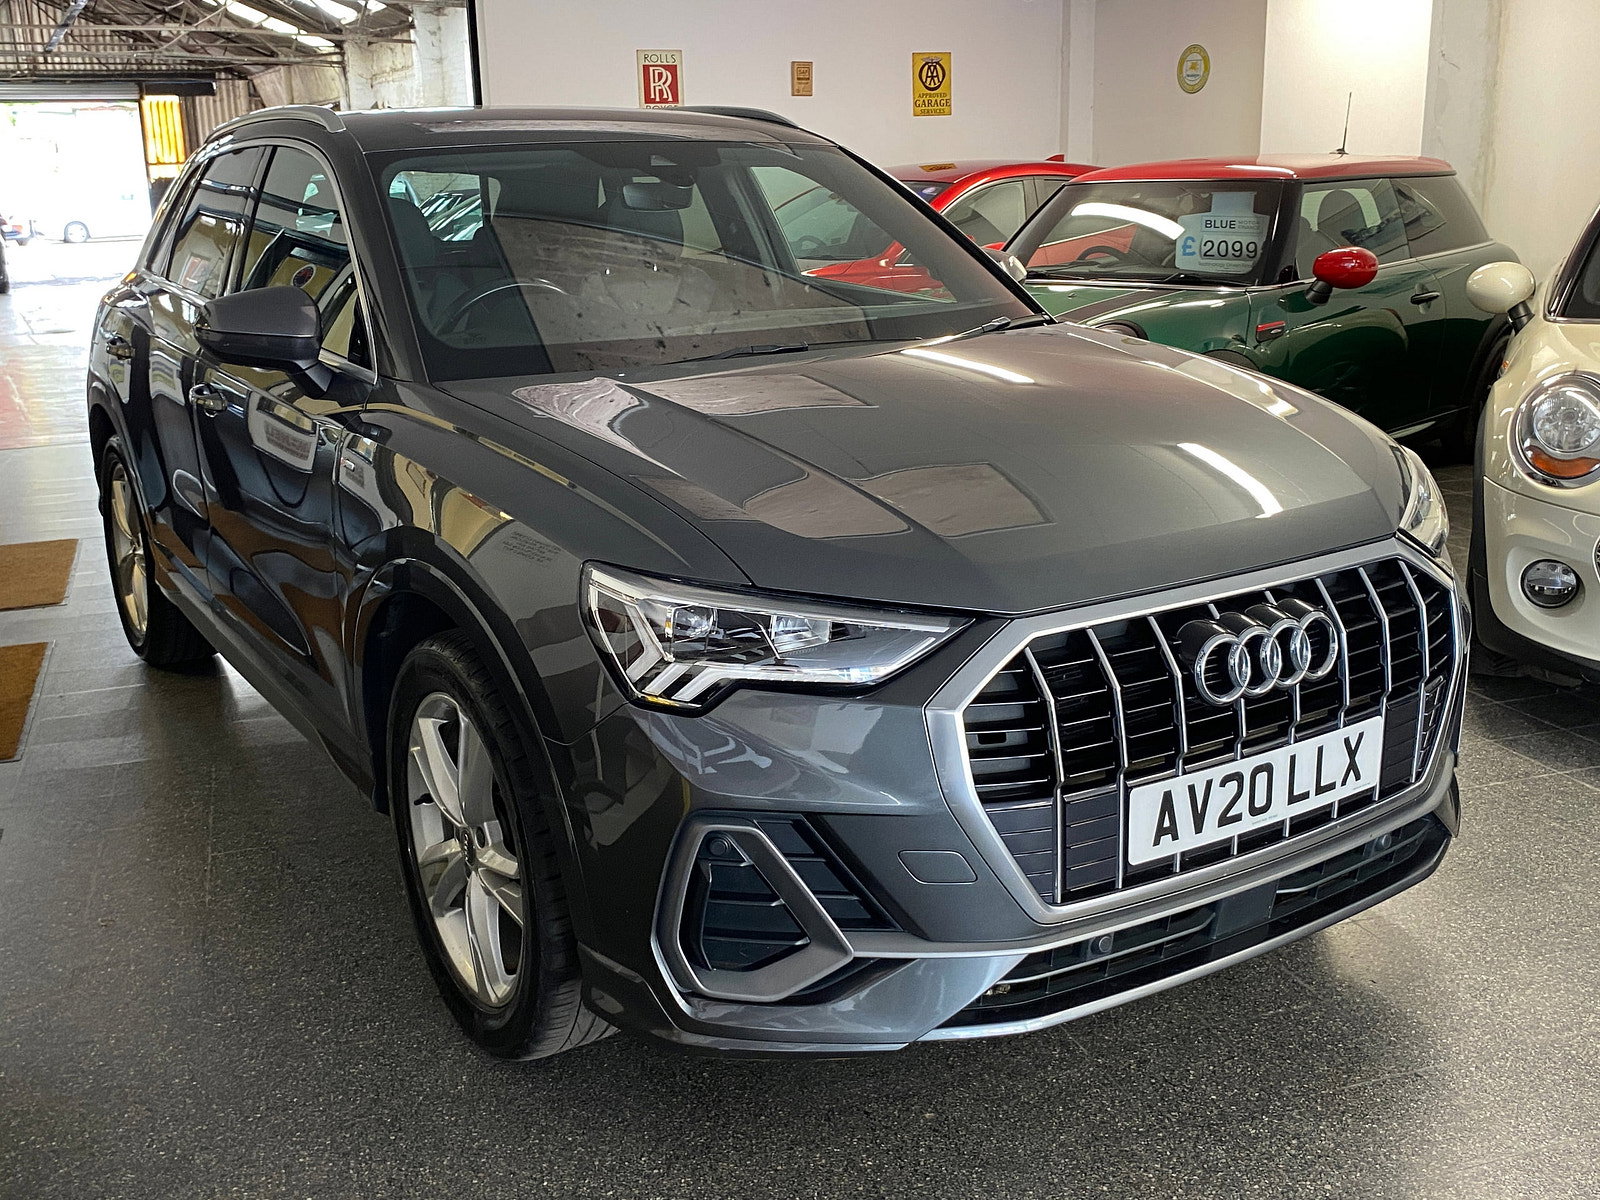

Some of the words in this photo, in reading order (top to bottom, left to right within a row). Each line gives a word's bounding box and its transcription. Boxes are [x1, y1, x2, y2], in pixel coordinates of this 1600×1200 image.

[644, 54, 677, 63] ROLLS
[914, 98, 951, 108] GARAGE
[1205, 219, 1236, 229] BLUE
[1182, 236, 1197, 257] £
[1203, 240, 1258, 259] 2099
[1152, 761, 1274, 847] AV20
[1286, 731, 1365, 806] LLX
